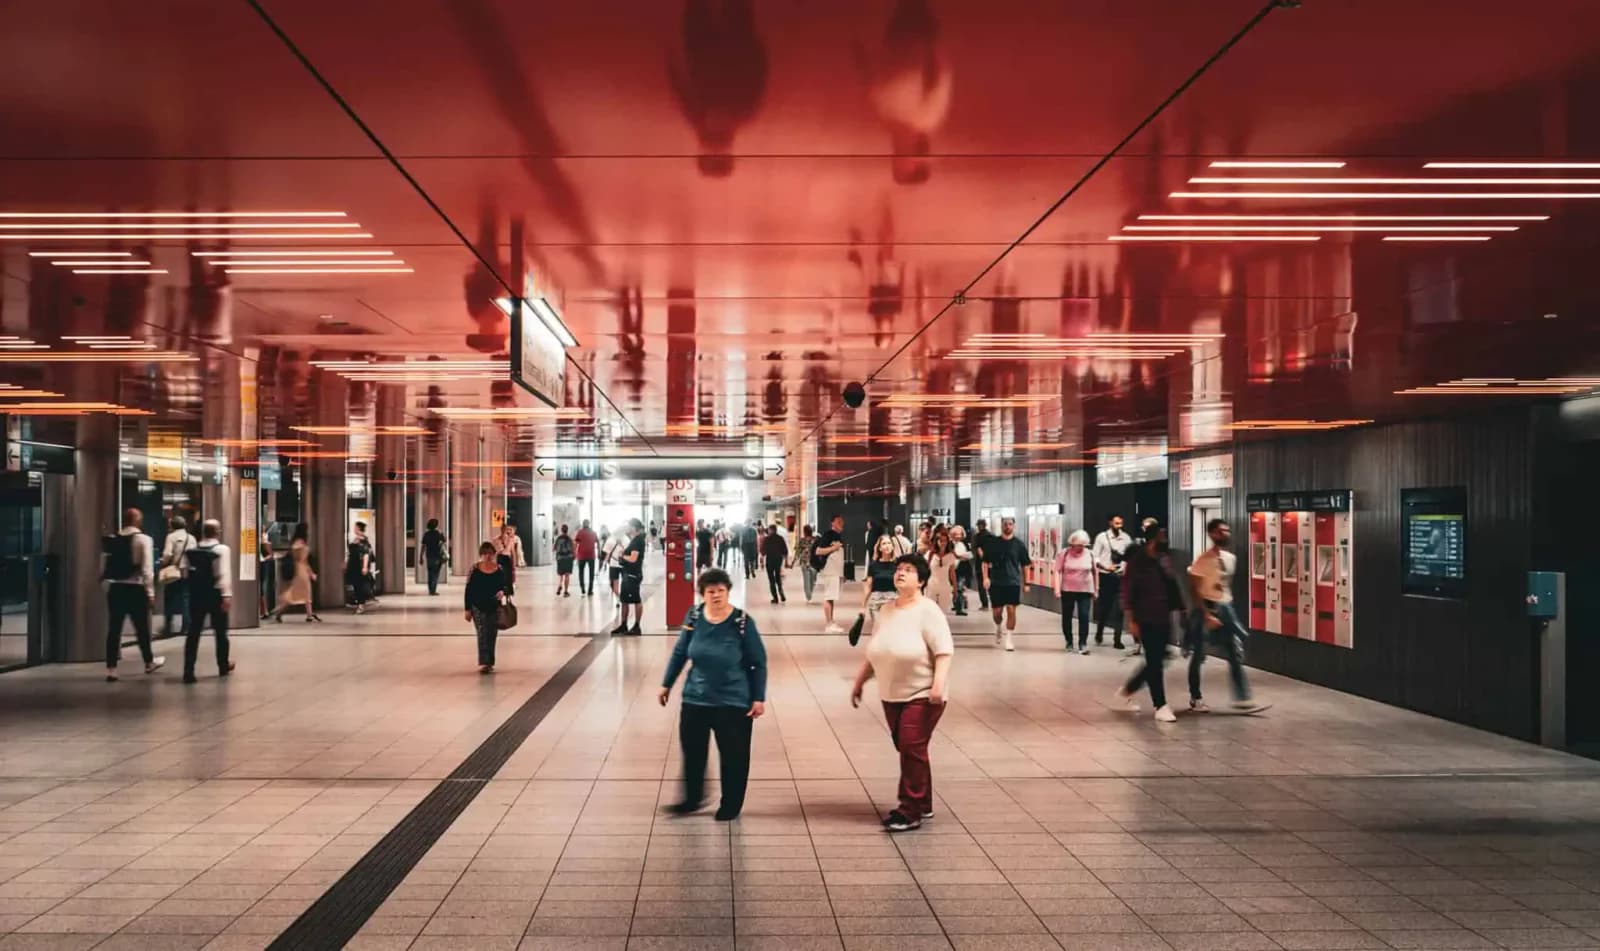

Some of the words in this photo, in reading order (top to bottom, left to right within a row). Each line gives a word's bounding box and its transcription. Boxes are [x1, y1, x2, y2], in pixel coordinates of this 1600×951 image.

[582, 462, 595, 477] U
[603, 462, 617, 478] S
[744, 461, 759, 478] S
[666, 479, 694, 491] SOS
